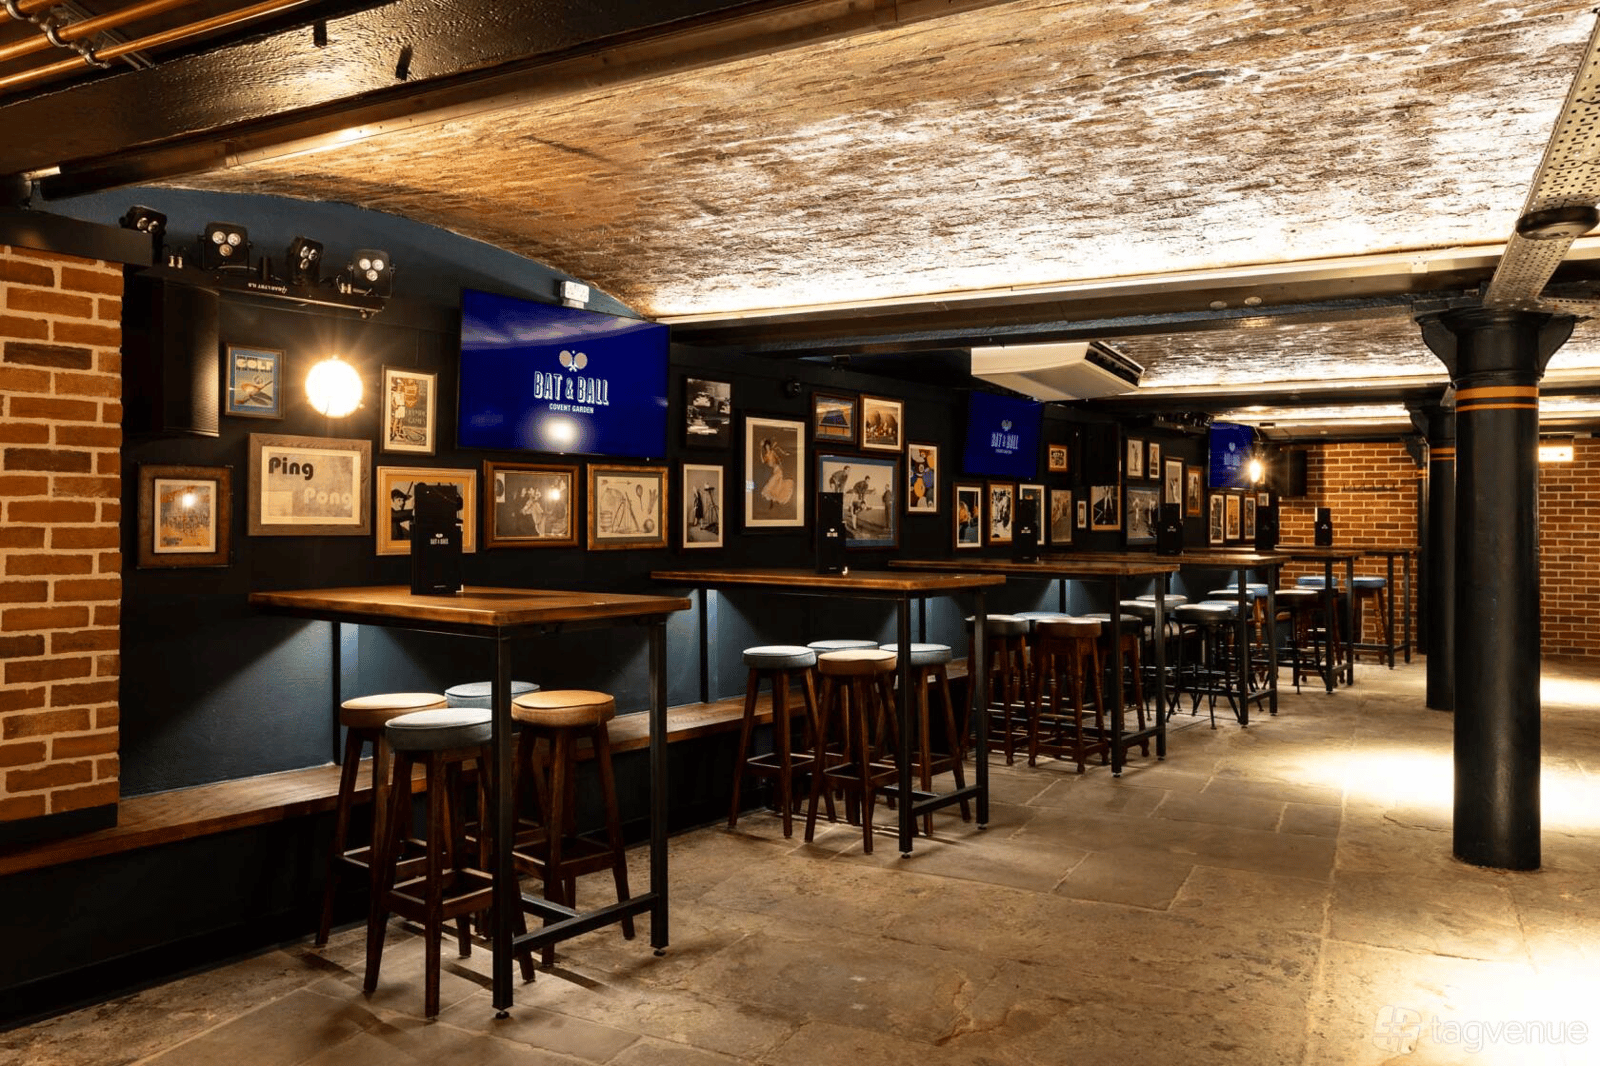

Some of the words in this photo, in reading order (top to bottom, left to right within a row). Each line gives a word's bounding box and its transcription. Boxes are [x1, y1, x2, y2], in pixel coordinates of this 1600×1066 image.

[236, 358, 274, 371] GOLF
[533, 370, 563, 400] BAT
[565, 377, 574, 400] &
[576, 376, 609, 406] BALL
[549, 403, 571, 412] COVENT
[572, 405, 594, 414] GARDEN
[268, 456, 314, 481] Ping
[303, 486, 352, 510] Pong
